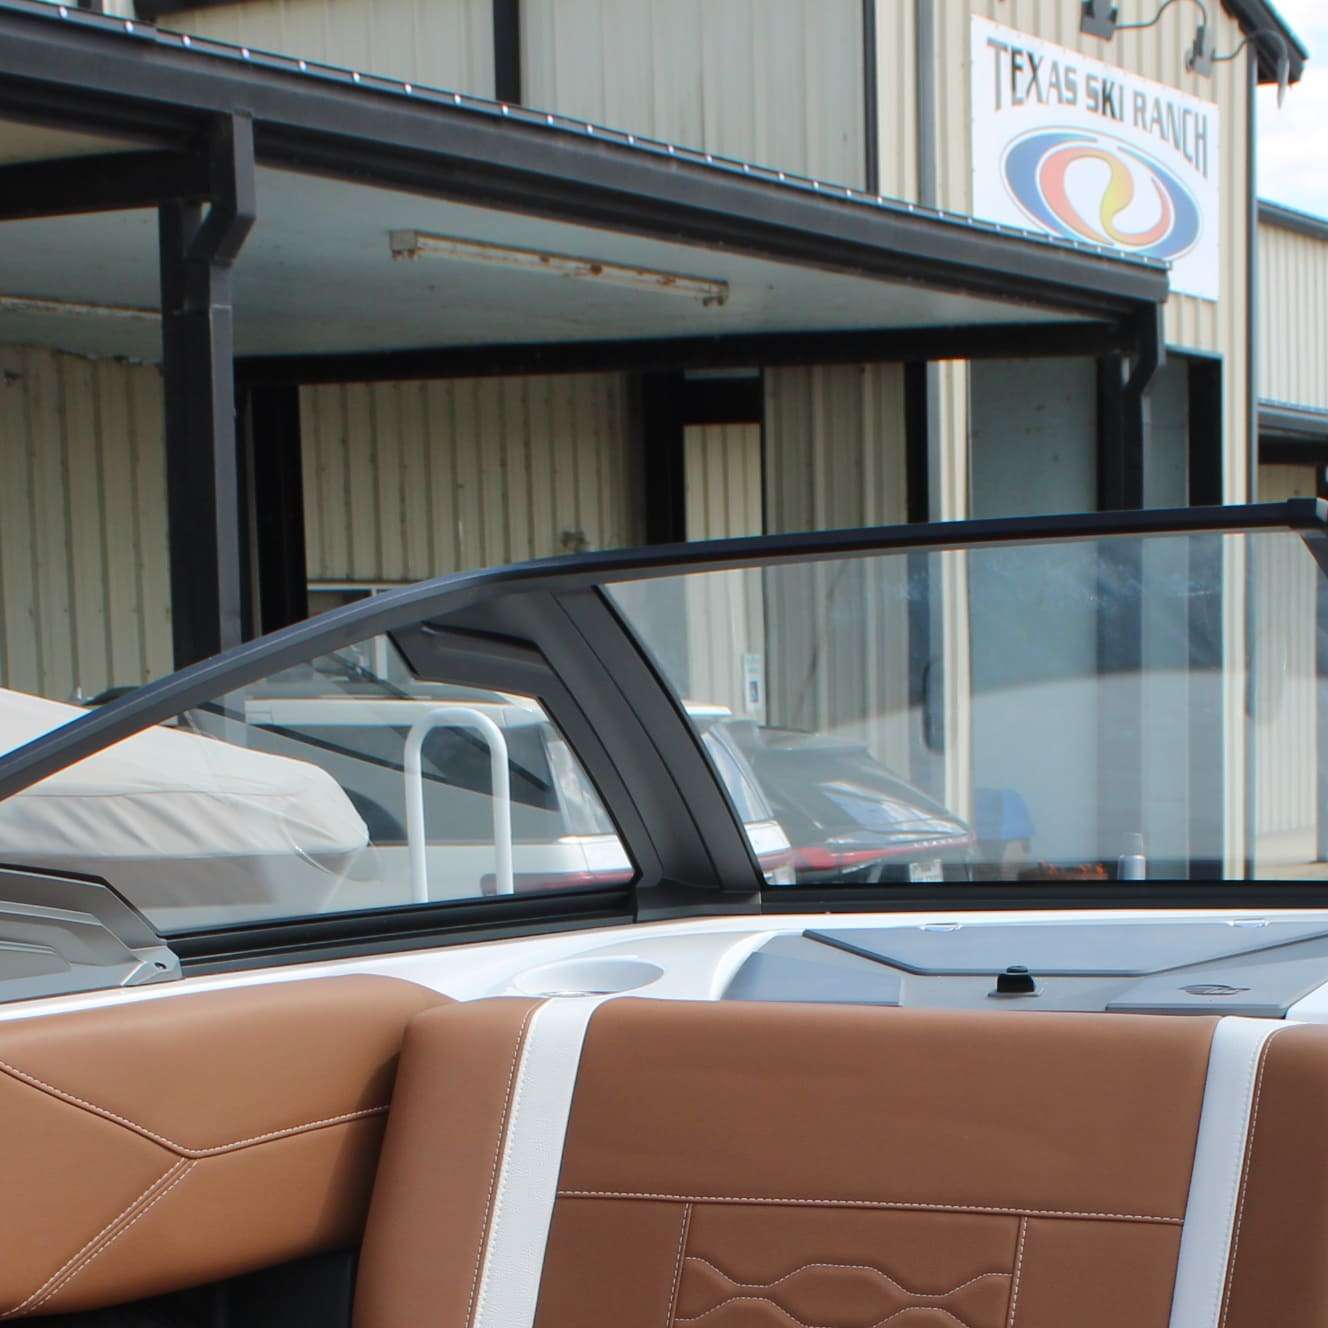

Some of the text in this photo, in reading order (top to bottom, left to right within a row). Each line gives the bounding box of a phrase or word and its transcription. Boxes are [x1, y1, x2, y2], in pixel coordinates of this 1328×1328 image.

[987, 36, 1208, 179] TEXAS SKI RANCH
